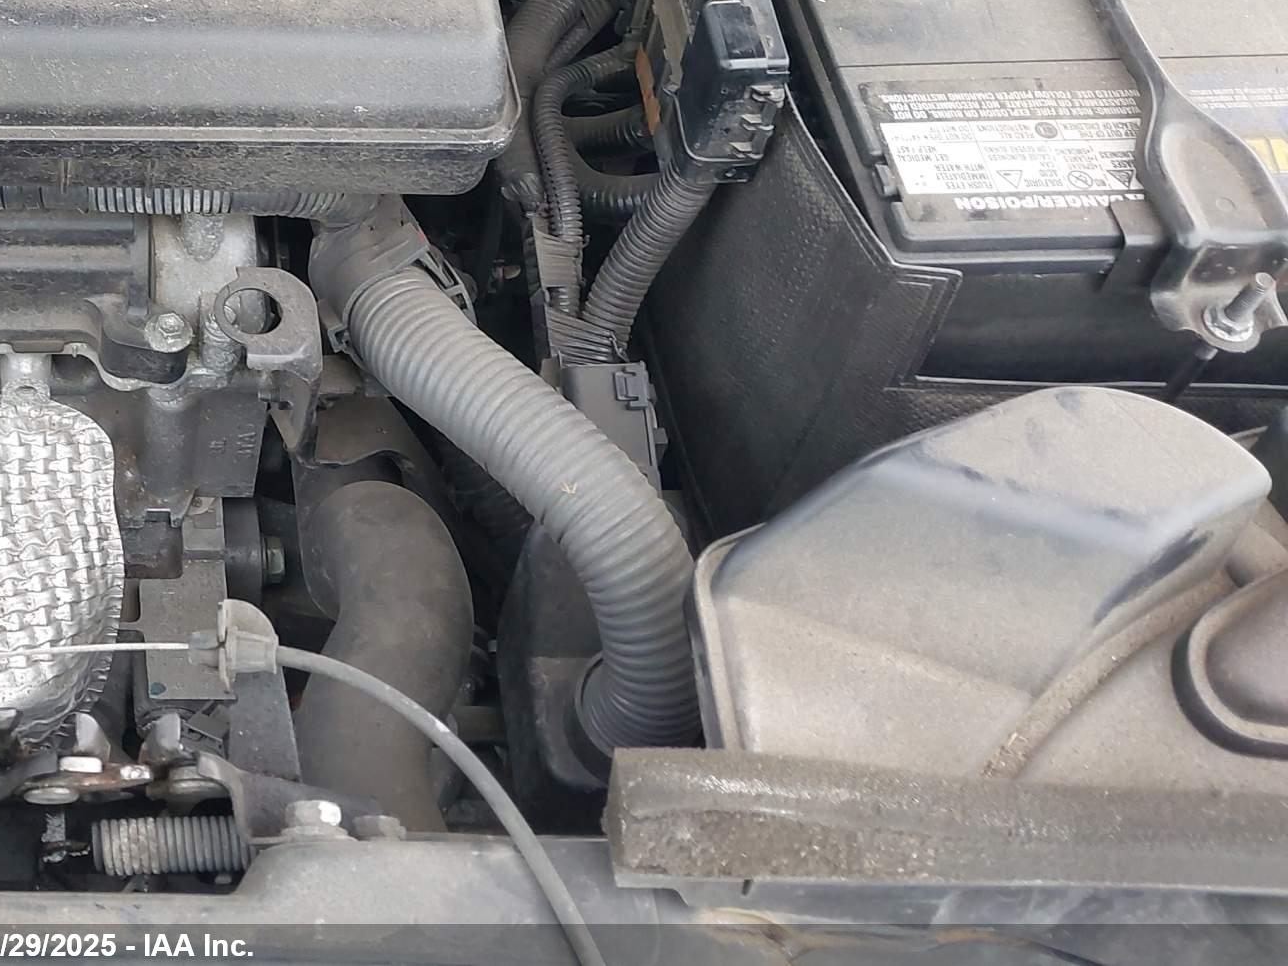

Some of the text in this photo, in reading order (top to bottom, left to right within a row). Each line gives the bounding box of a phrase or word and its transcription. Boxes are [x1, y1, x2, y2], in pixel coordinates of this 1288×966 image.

[889, 102, 909, 111] FOR
[981, 100, 1000, 109] NOT
[893, 110, 913, 119] NOT
